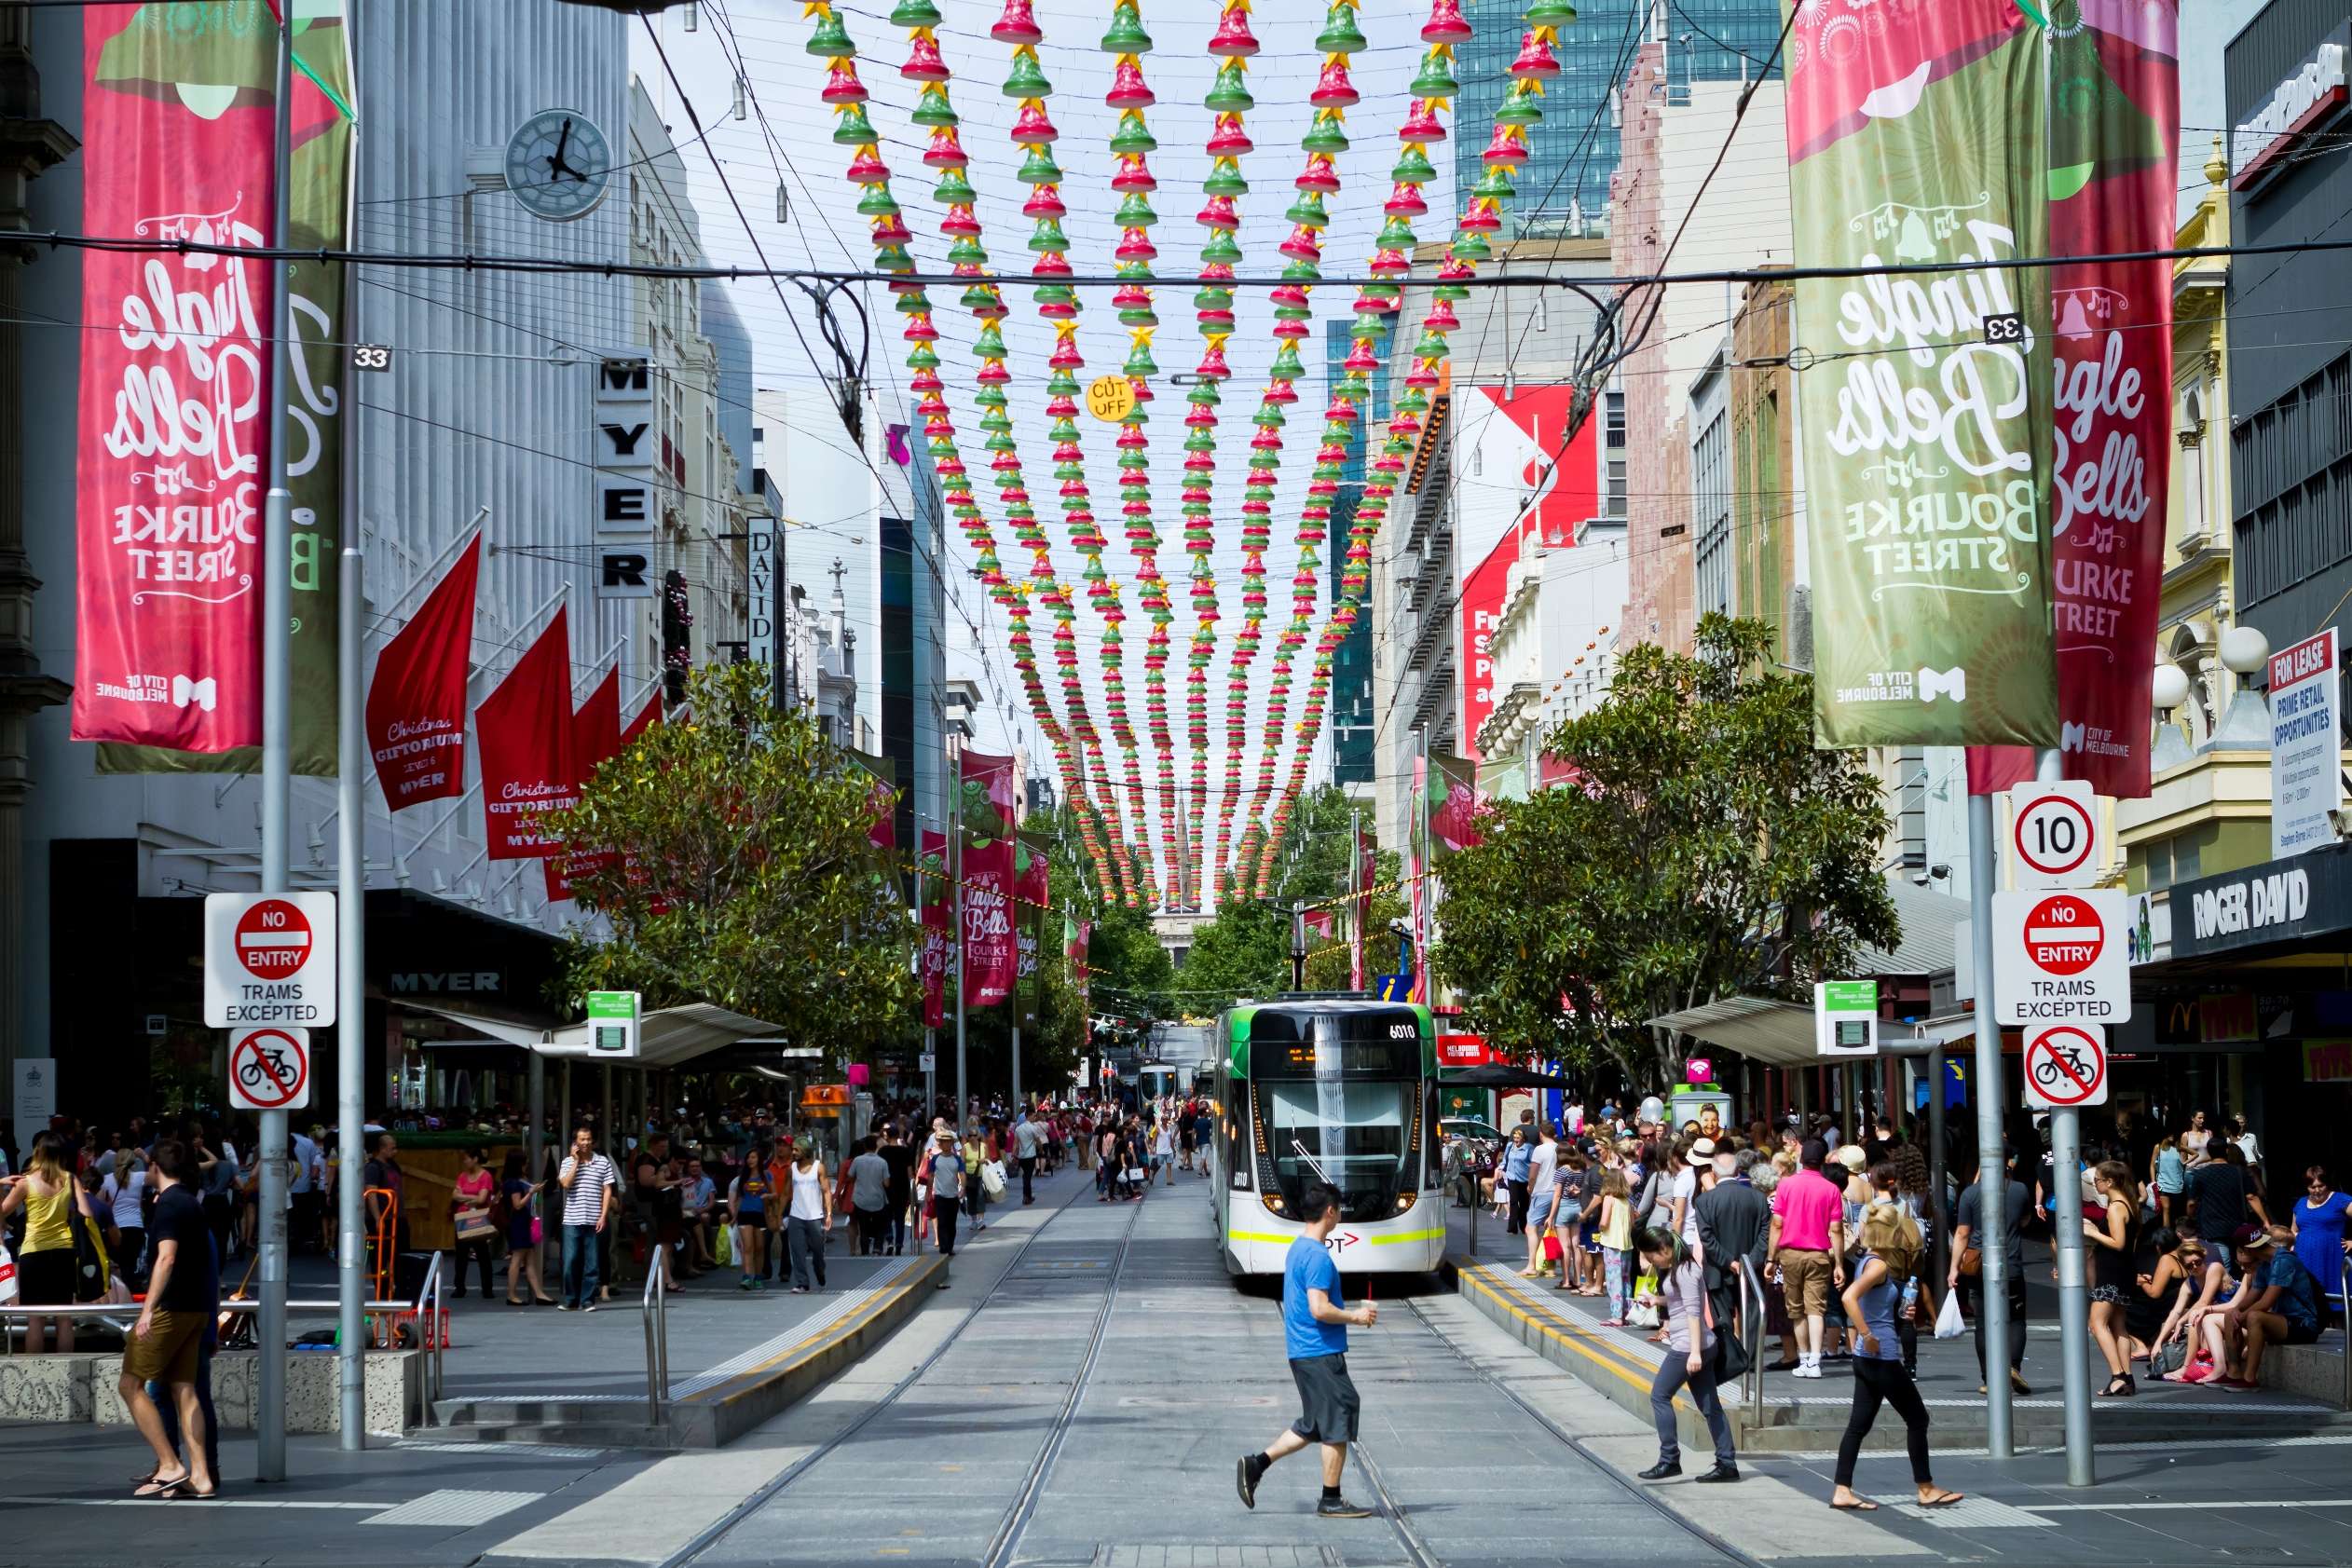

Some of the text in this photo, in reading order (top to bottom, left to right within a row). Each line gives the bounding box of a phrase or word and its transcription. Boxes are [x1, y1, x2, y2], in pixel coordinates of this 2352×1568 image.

[355, 348, 387, 368] 33
[1092, 382, 1125, 399] CUT
[2054, 331, 2145, 443] ngle
[599, 357, 650, 587] MYER
[752, 532, 772, 638] DAVID
[2056, 558, 2133, 604] URKE
[2054, 602, 2121, 637] TREET
[2275, 640, 2324, 686] FOR LEASE
[2277, 683, 2324, 720] PRIME RETAIL
[388, 716, 452, 742] Christmas
[2087, 728, 2112, 742] CITY OF
[2275, 707, 2330, 746] OPPORTUNITIES
[376, 732, 463, 762] GIFTORIUM
[2086, 740, 2129, 757] MELBOURNE
[502, 781, 568, 799] Christmas
[489, 797, 579, 813] GIFTORIUM
[2035, 817, 2075, 854] 10
[2193, 869, 2309, 939] ROGER DAVID
[263, 911, 285, 927] NO
[966, 908, 1010, 941] Bells
[2052, 907, 2076, 923] NO
[247, 950, 302, 967] ENTRY
[2038, 946, 2095, 962] ENTRY
[391, 972, 500, 991] MYER
[2031, 980, 2096, 997] TRAMS
[242, 984, 303, 1000] TRAMS
[226, 1005, 318, 1021] EXCEPTED
[2017, 1001, 2112, 1017] EXCEPTED
[1389, 1025, 1415, 1039] 6010
